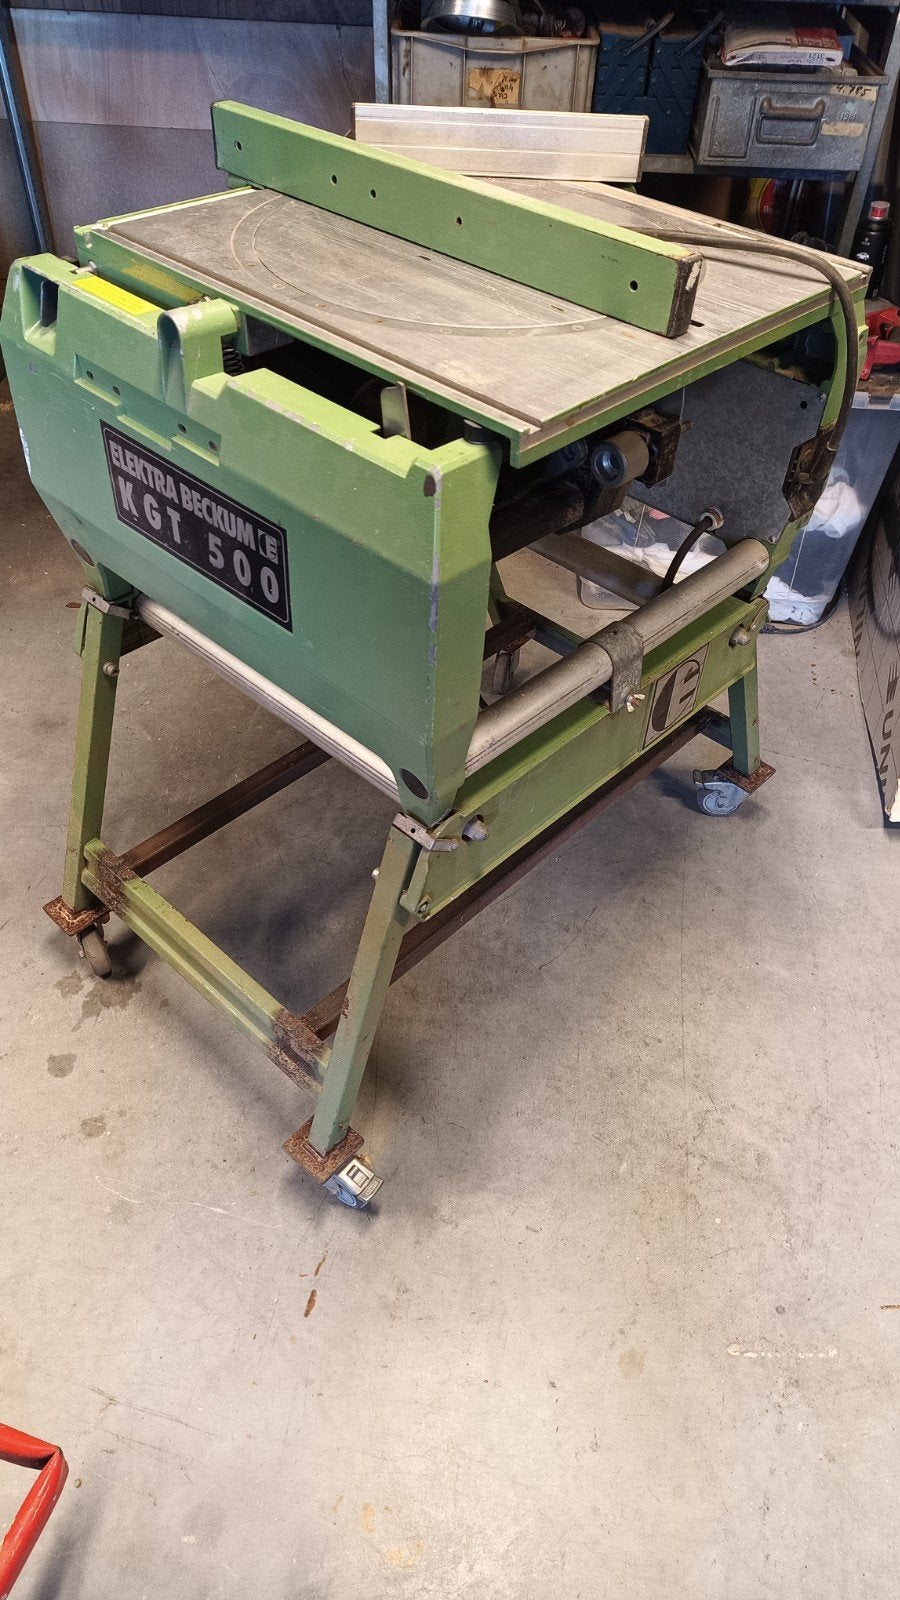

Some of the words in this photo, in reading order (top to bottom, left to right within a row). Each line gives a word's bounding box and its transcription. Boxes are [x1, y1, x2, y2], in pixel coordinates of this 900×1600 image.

[108, 440, 179, 504] ELEKTRA
[179, 483, 256, 551] BECKUM
[208, 532, 280, 604] 500
